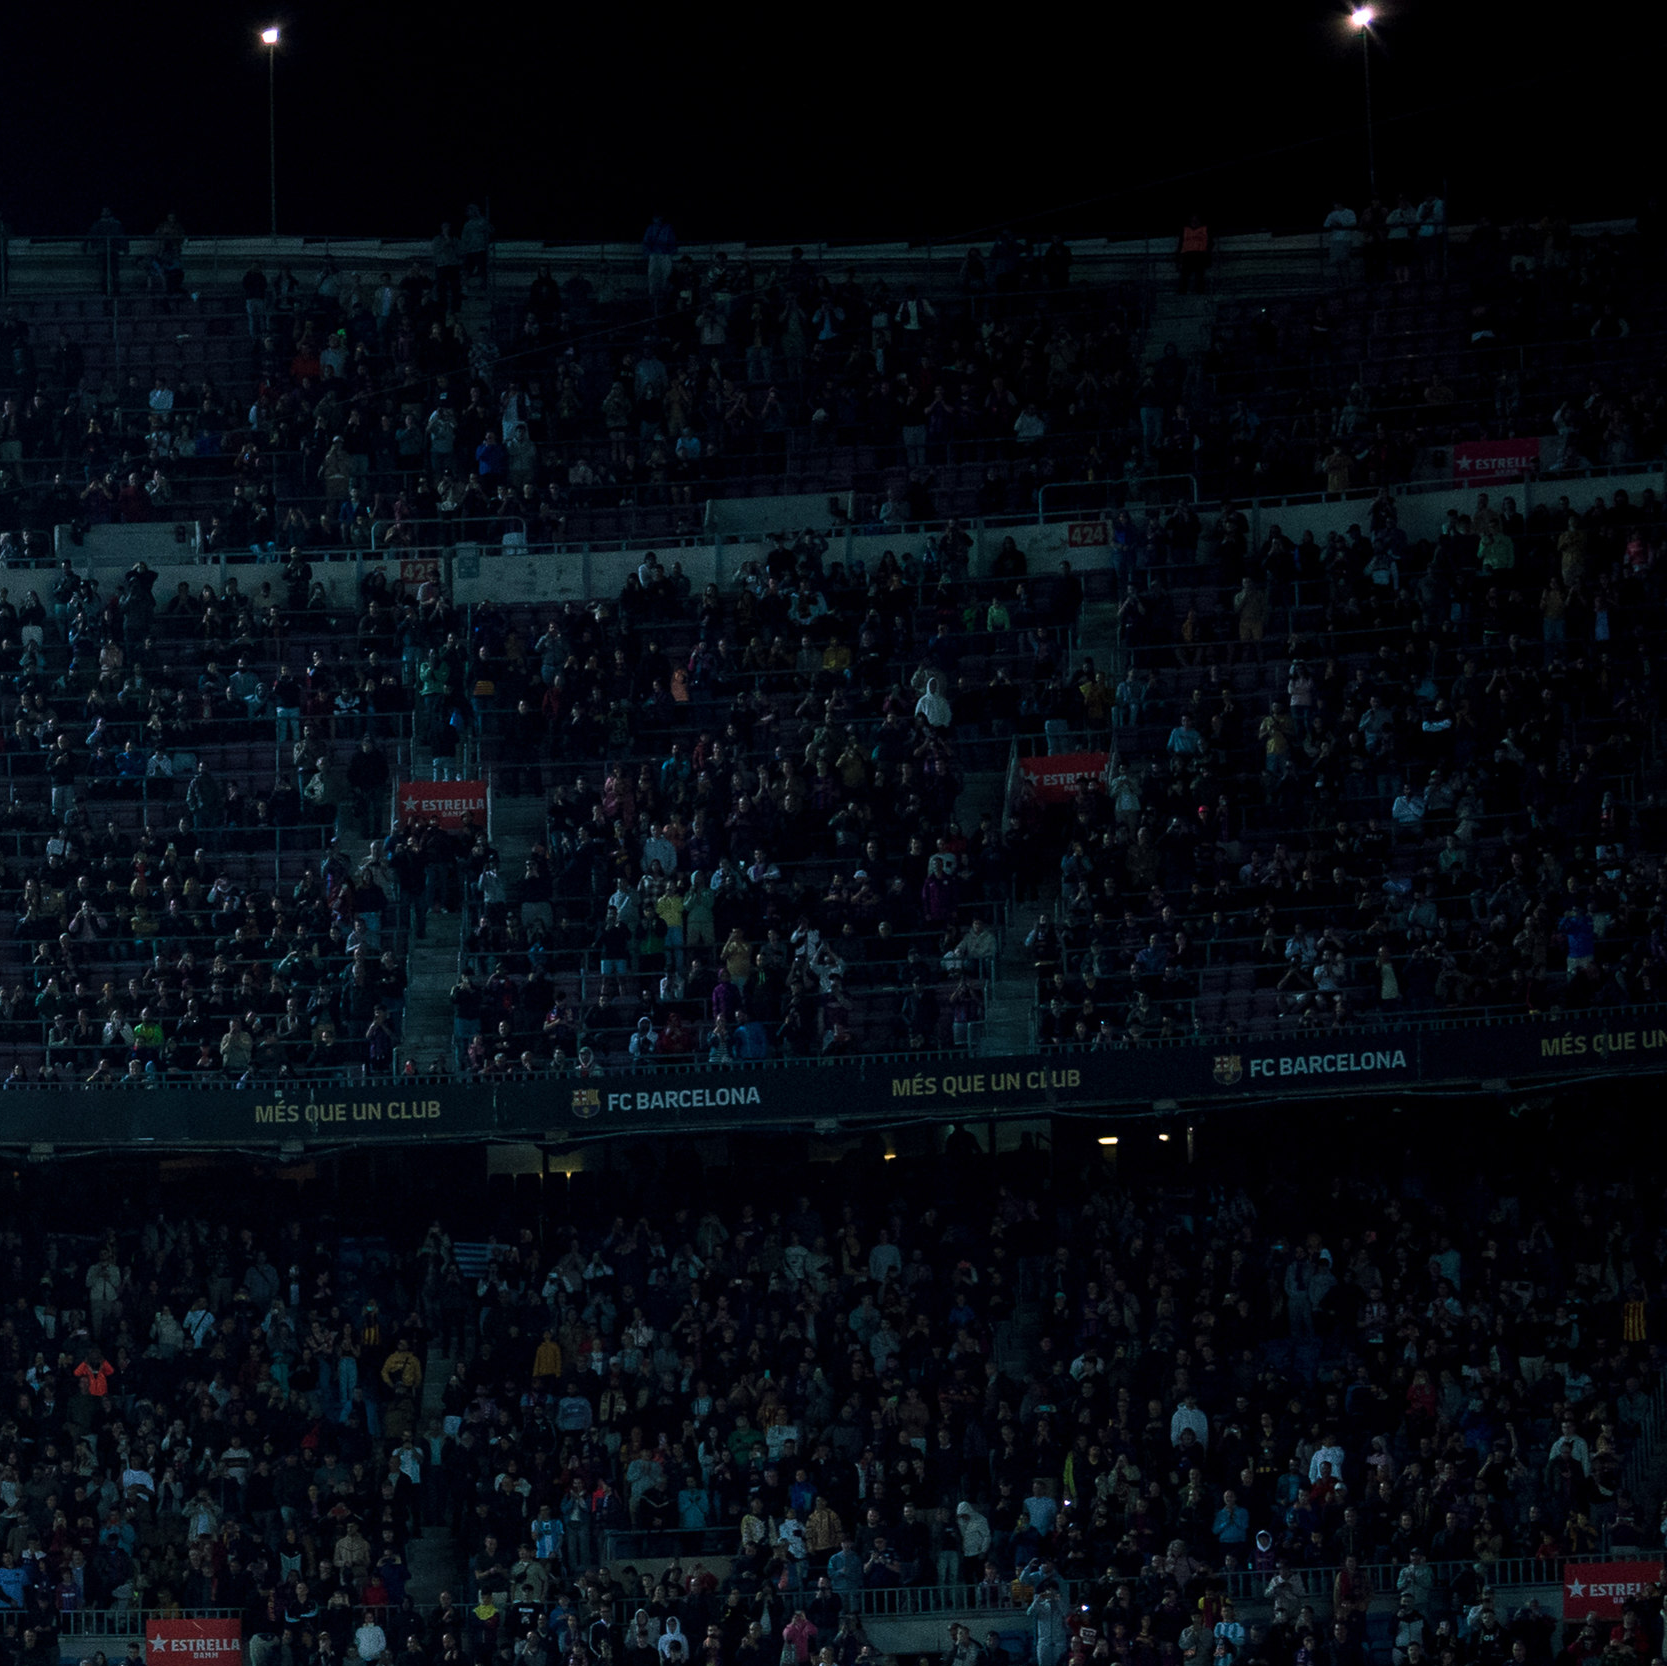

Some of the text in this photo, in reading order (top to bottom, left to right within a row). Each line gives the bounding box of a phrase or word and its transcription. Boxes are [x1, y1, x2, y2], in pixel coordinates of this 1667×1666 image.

[1071, 525, 1105, 545] 424
[423, 799, 484, 811] ESTRELLA
[1541, 1031, 1587, 1057] MÉS
[1592, 1032, 1636, 1053] QUE
[1250, 1050, 1407, 1077] FC BARCELONA
[892, 1070, 1081, 1097] MÉS QUE UN CLUB
[608, 1087, 762, 1111] FC BARCELONA
[255, 1100, 441, 1123] MÉS QUE UN CLUB
[170, 1639, 240, 1652] ESTRELLA
[193, 1651, 219, 1659] DAMM
